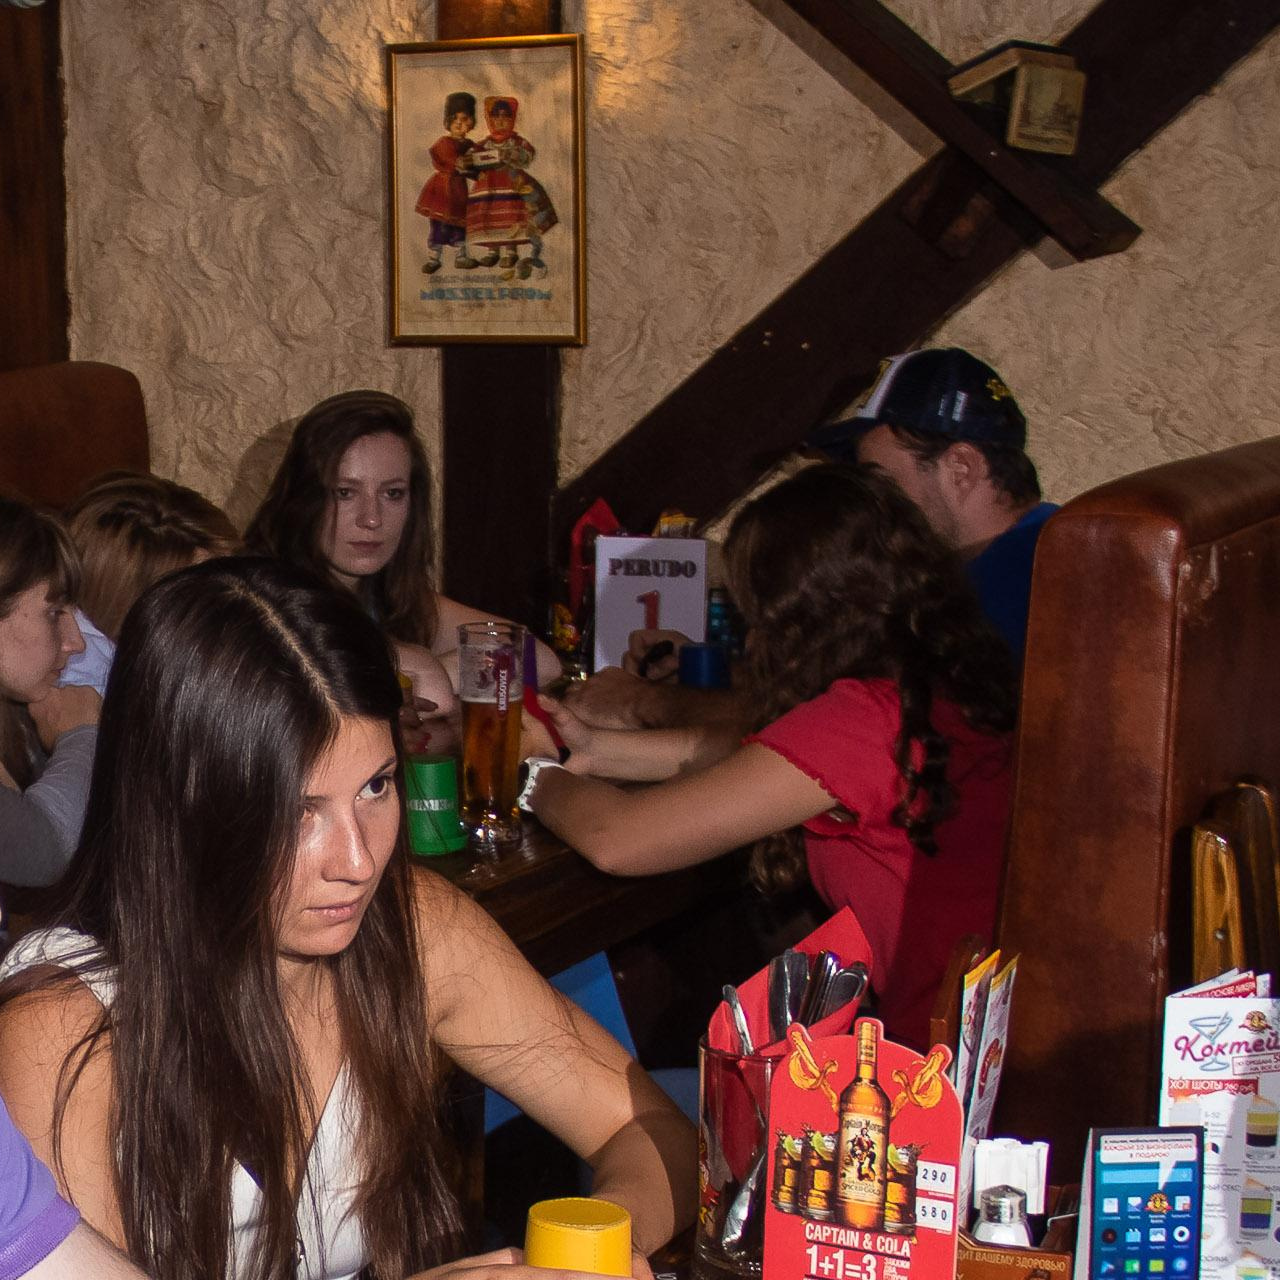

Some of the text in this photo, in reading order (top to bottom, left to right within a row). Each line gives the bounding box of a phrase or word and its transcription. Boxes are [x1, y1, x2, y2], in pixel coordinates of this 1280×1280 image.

[607, 557, 697, 579] PERUDO
[636, 590, 661, 630] 1
[922, 1168, 947, 1183] 290
[921, 1205, 947, 1221] 580
[805, 1222, 911, 1258] CAPTAIN & COLA
[975, 1251, 1015, 1266] ВАШЕМУ
[1015, 1256, 1066, 1272] ЗДОРОВЬЮ
